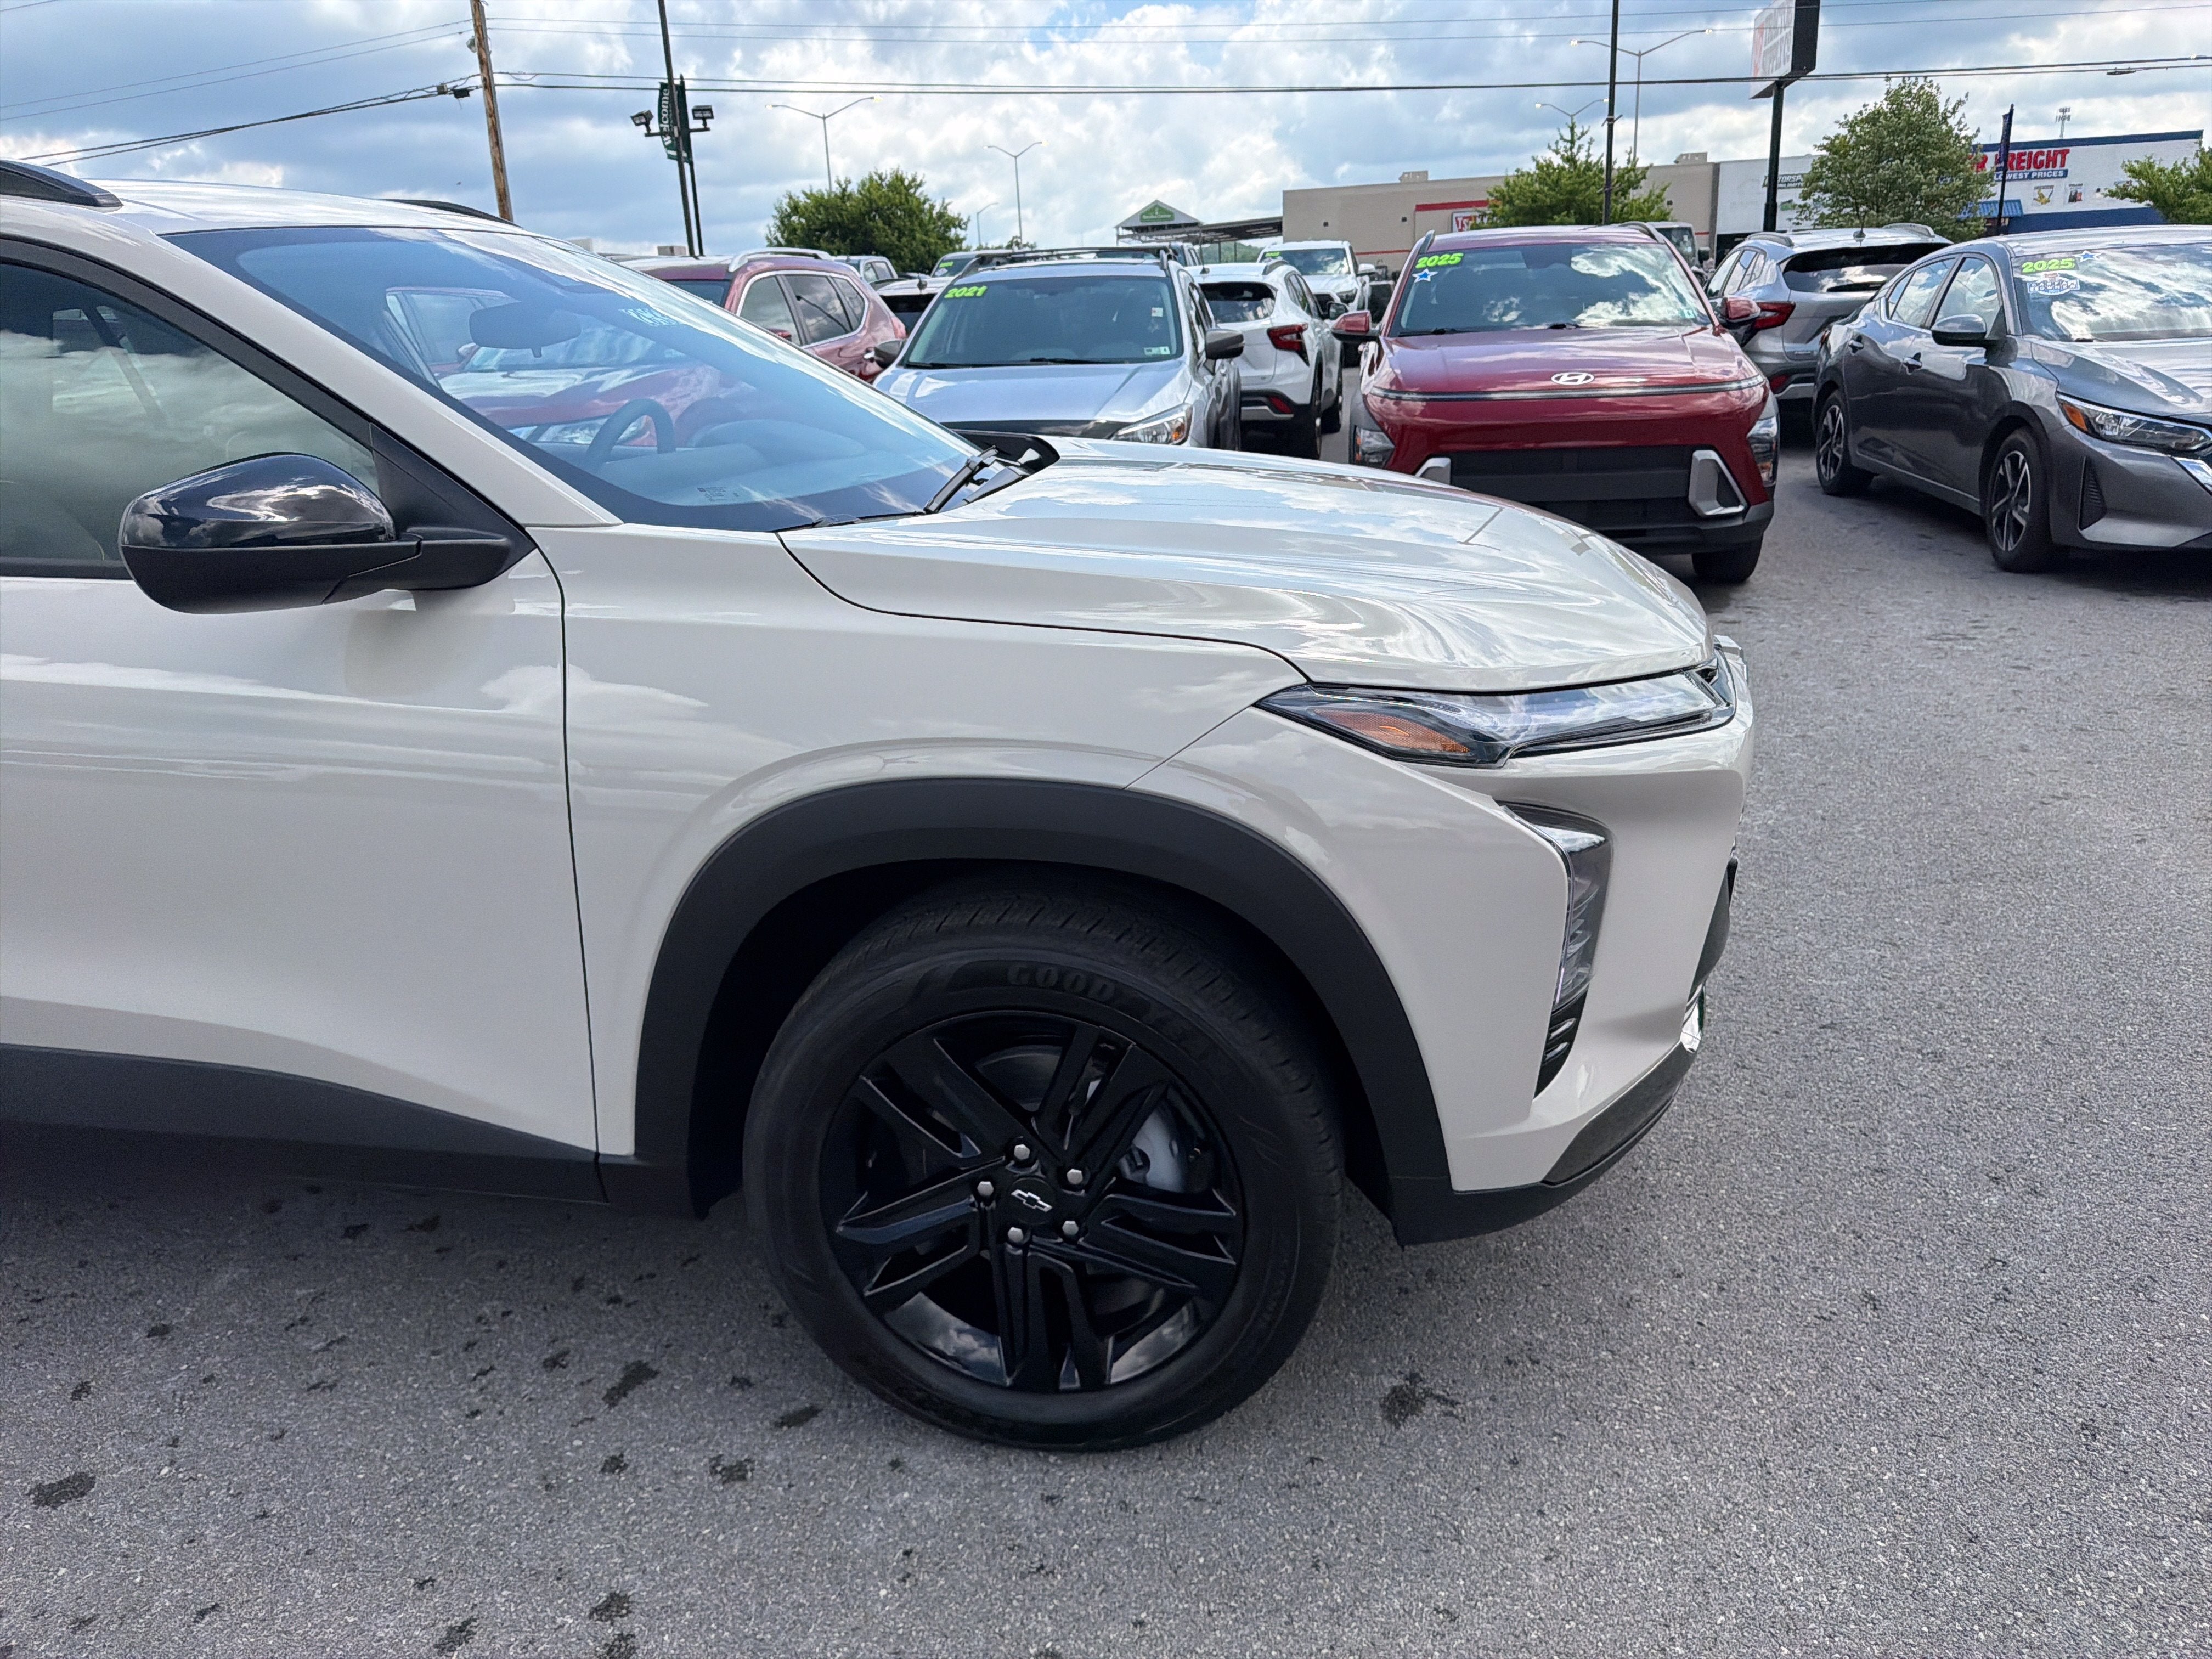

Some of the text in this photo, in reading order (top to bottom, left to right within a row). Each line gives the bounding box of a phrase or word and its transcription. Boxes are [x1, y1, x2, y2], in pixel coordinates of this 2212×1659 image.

[1415, 253, 1464, 268] 2025
[2022, 258, 2075, 273] 2025
[945, 286, 987, 298] 2021
